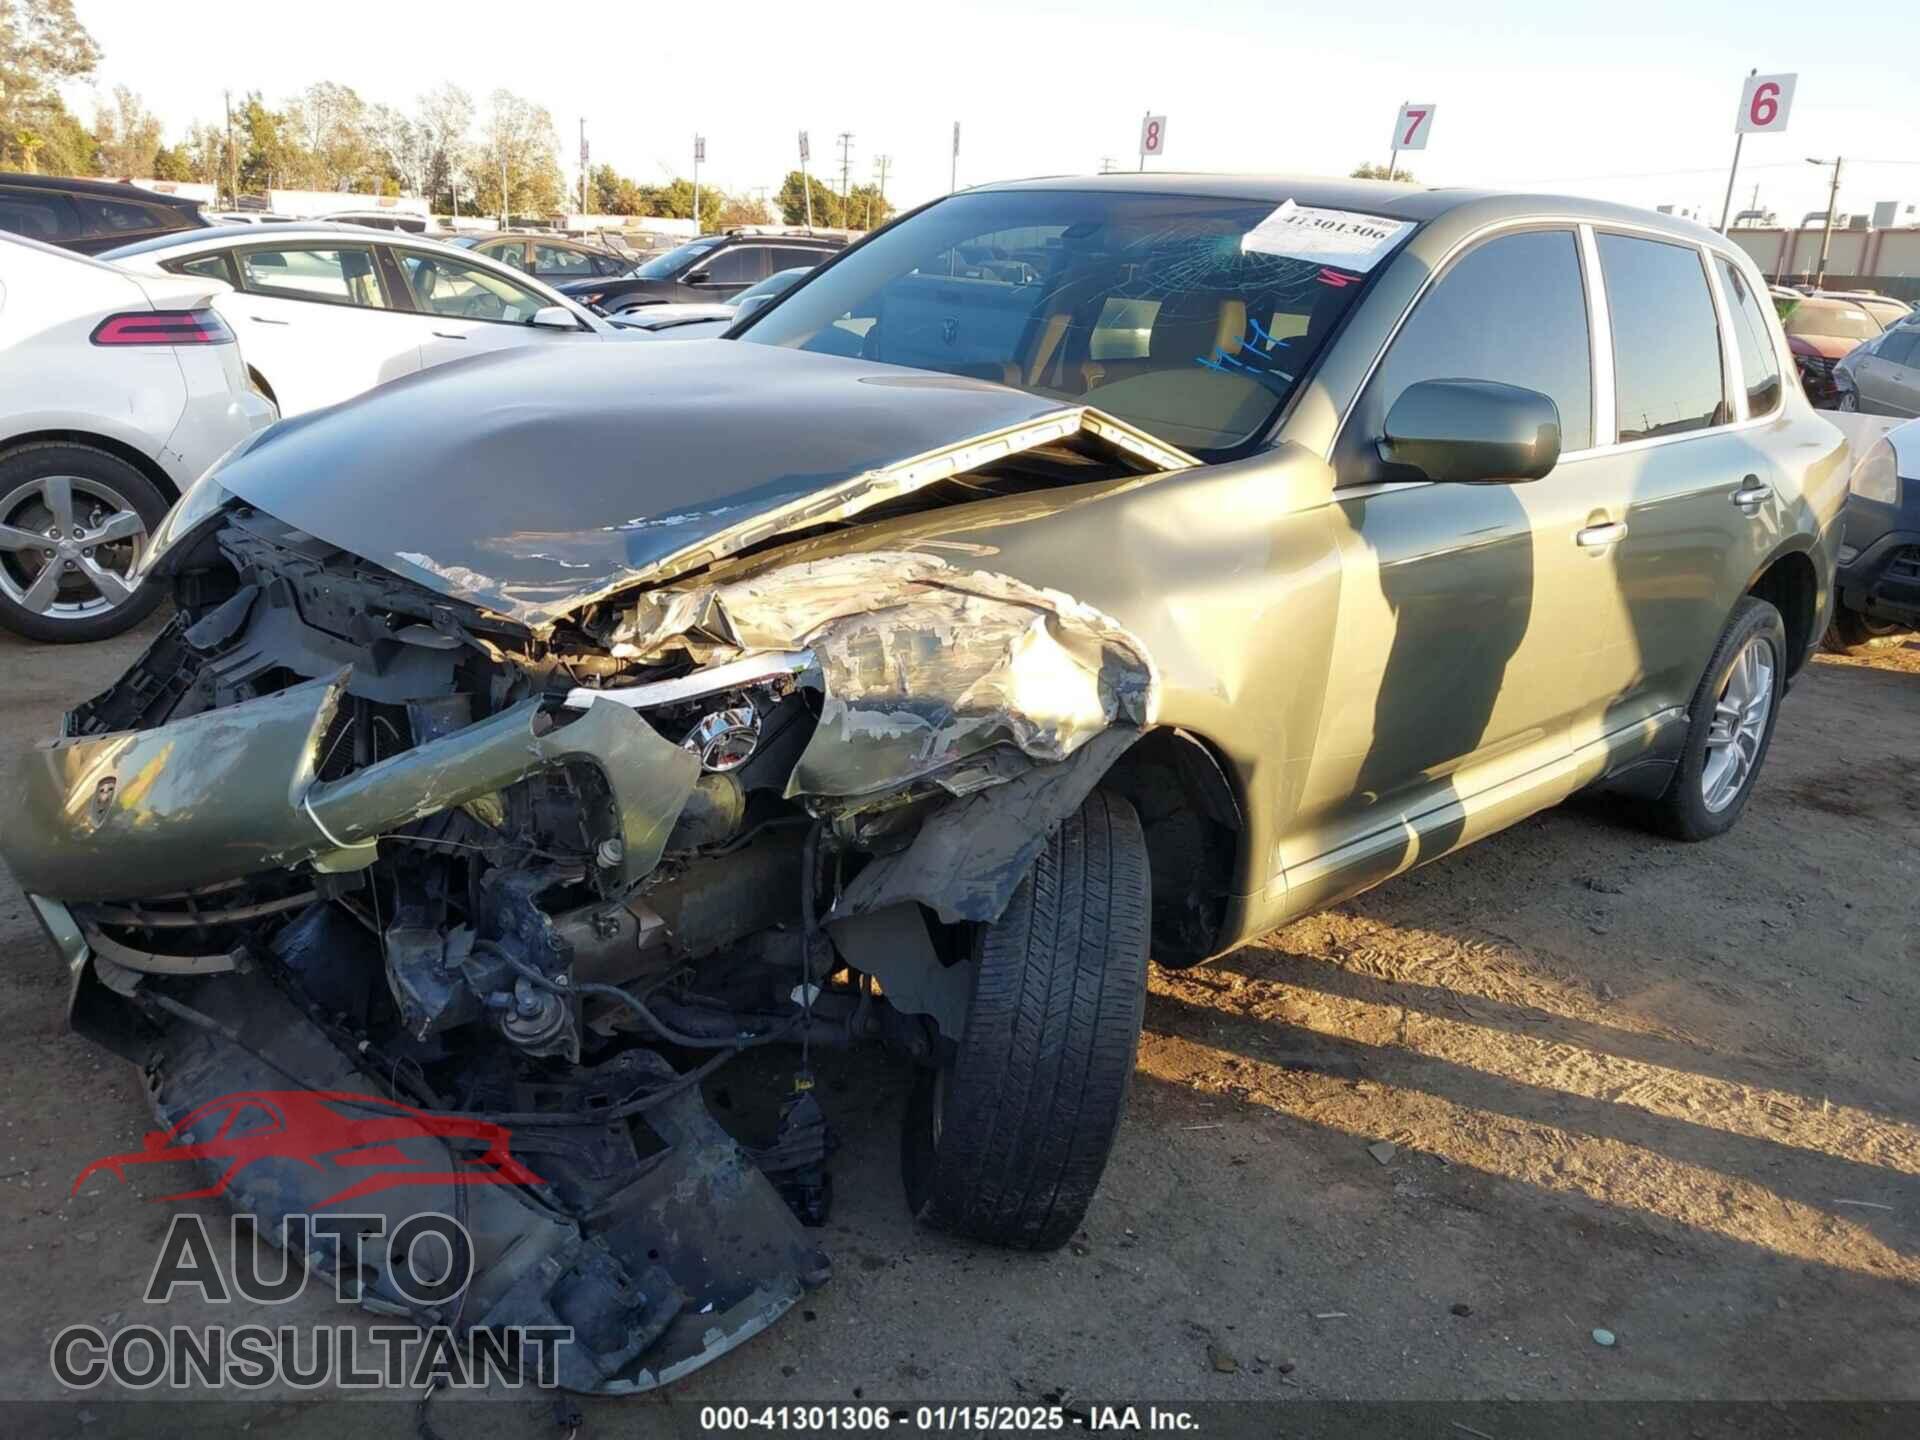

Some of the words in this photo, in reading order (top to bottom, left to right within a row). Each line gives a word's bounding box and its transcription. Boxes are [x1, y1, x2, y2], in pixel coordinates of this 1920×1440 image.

[1750, 82, 1780, 126] 6
[1145, 121, 1160, 151] 8
[1404, 111, 1427, 145] 7
